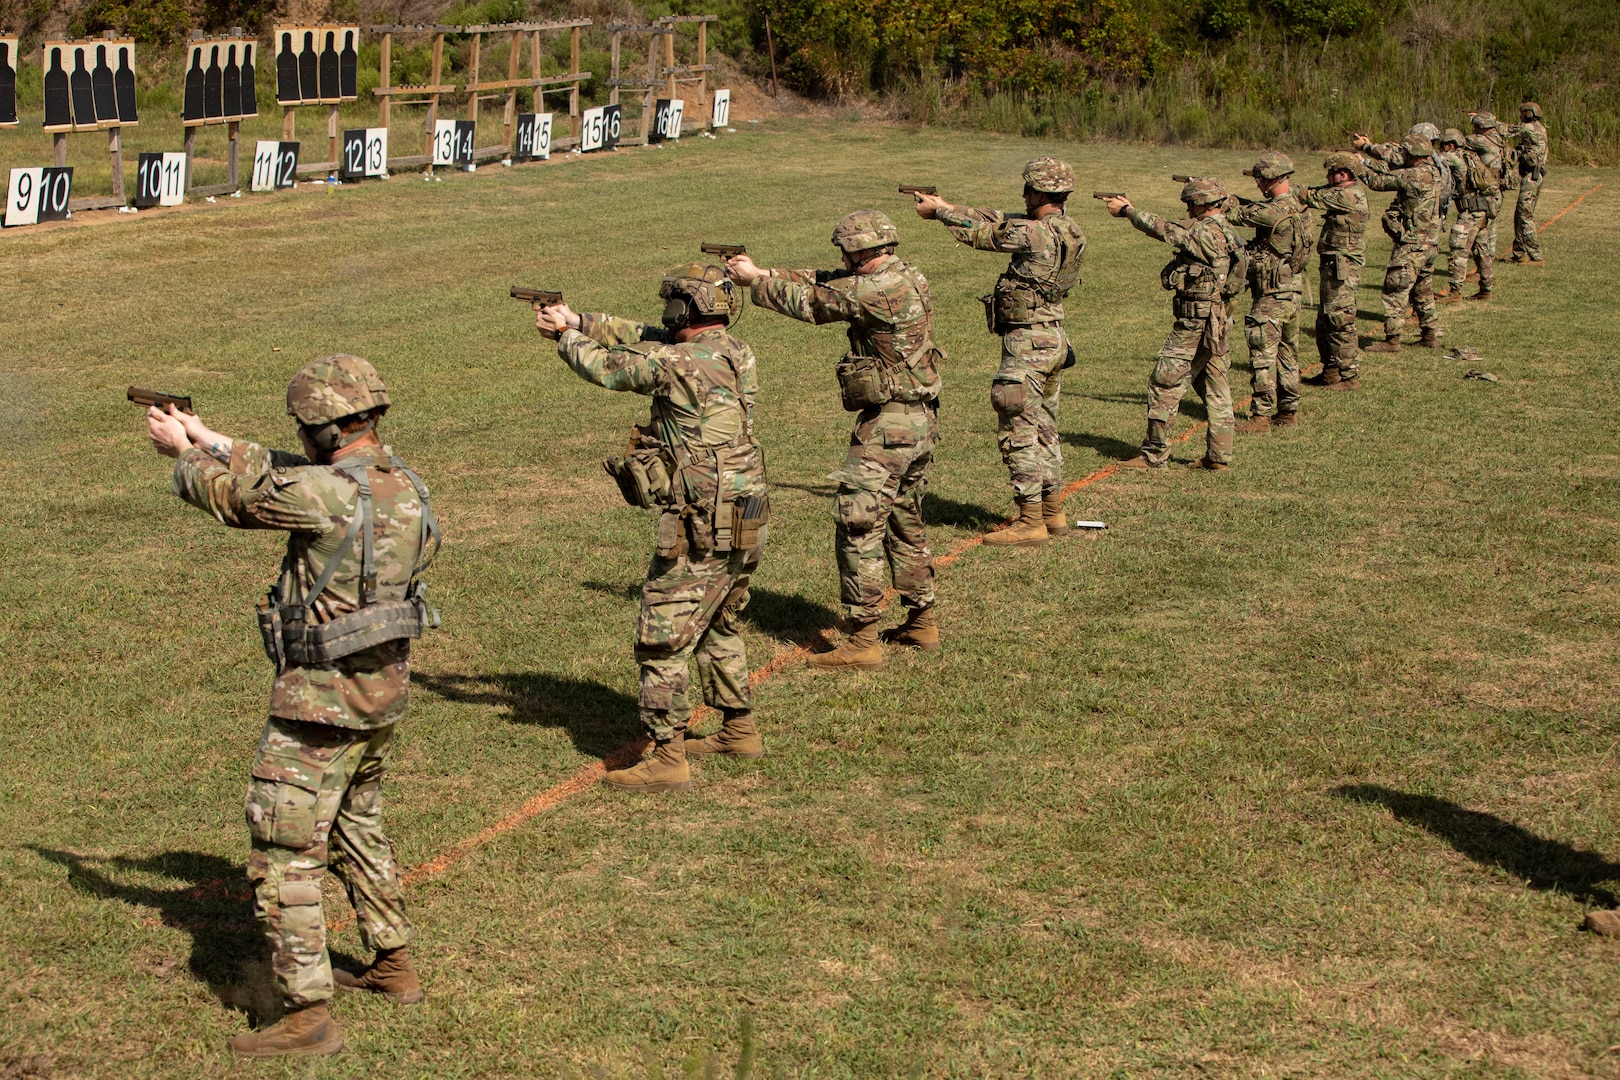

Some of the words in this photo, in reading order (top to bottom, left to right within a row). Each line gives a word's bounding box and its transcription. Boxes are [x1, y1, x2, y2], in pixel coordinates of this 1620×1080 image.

[583, 116, 601, 145] 15
[603, 110, 621, 141] 16
[656, 107, 668, 139] 16
[670, 108, 682, 138] 17
[716, 97, 728, 123] 17
[434, 129, 452, 160] 13
[454, 129, 473, 160] 14
[518, 122, 533, 152] 14
[535, 121, 549, 150] 15
[256, 152, 272, 185] 11
[276, 151, 295, 186] 12
[345, 139, 363, 173] 12
[367, 137, 382, 170] 13
[17, 172, 32, 211] 9
[41, 172, 70, 212] 10
[140, 159, 162, 197] 10
[164, 160, 180, 196] 11
